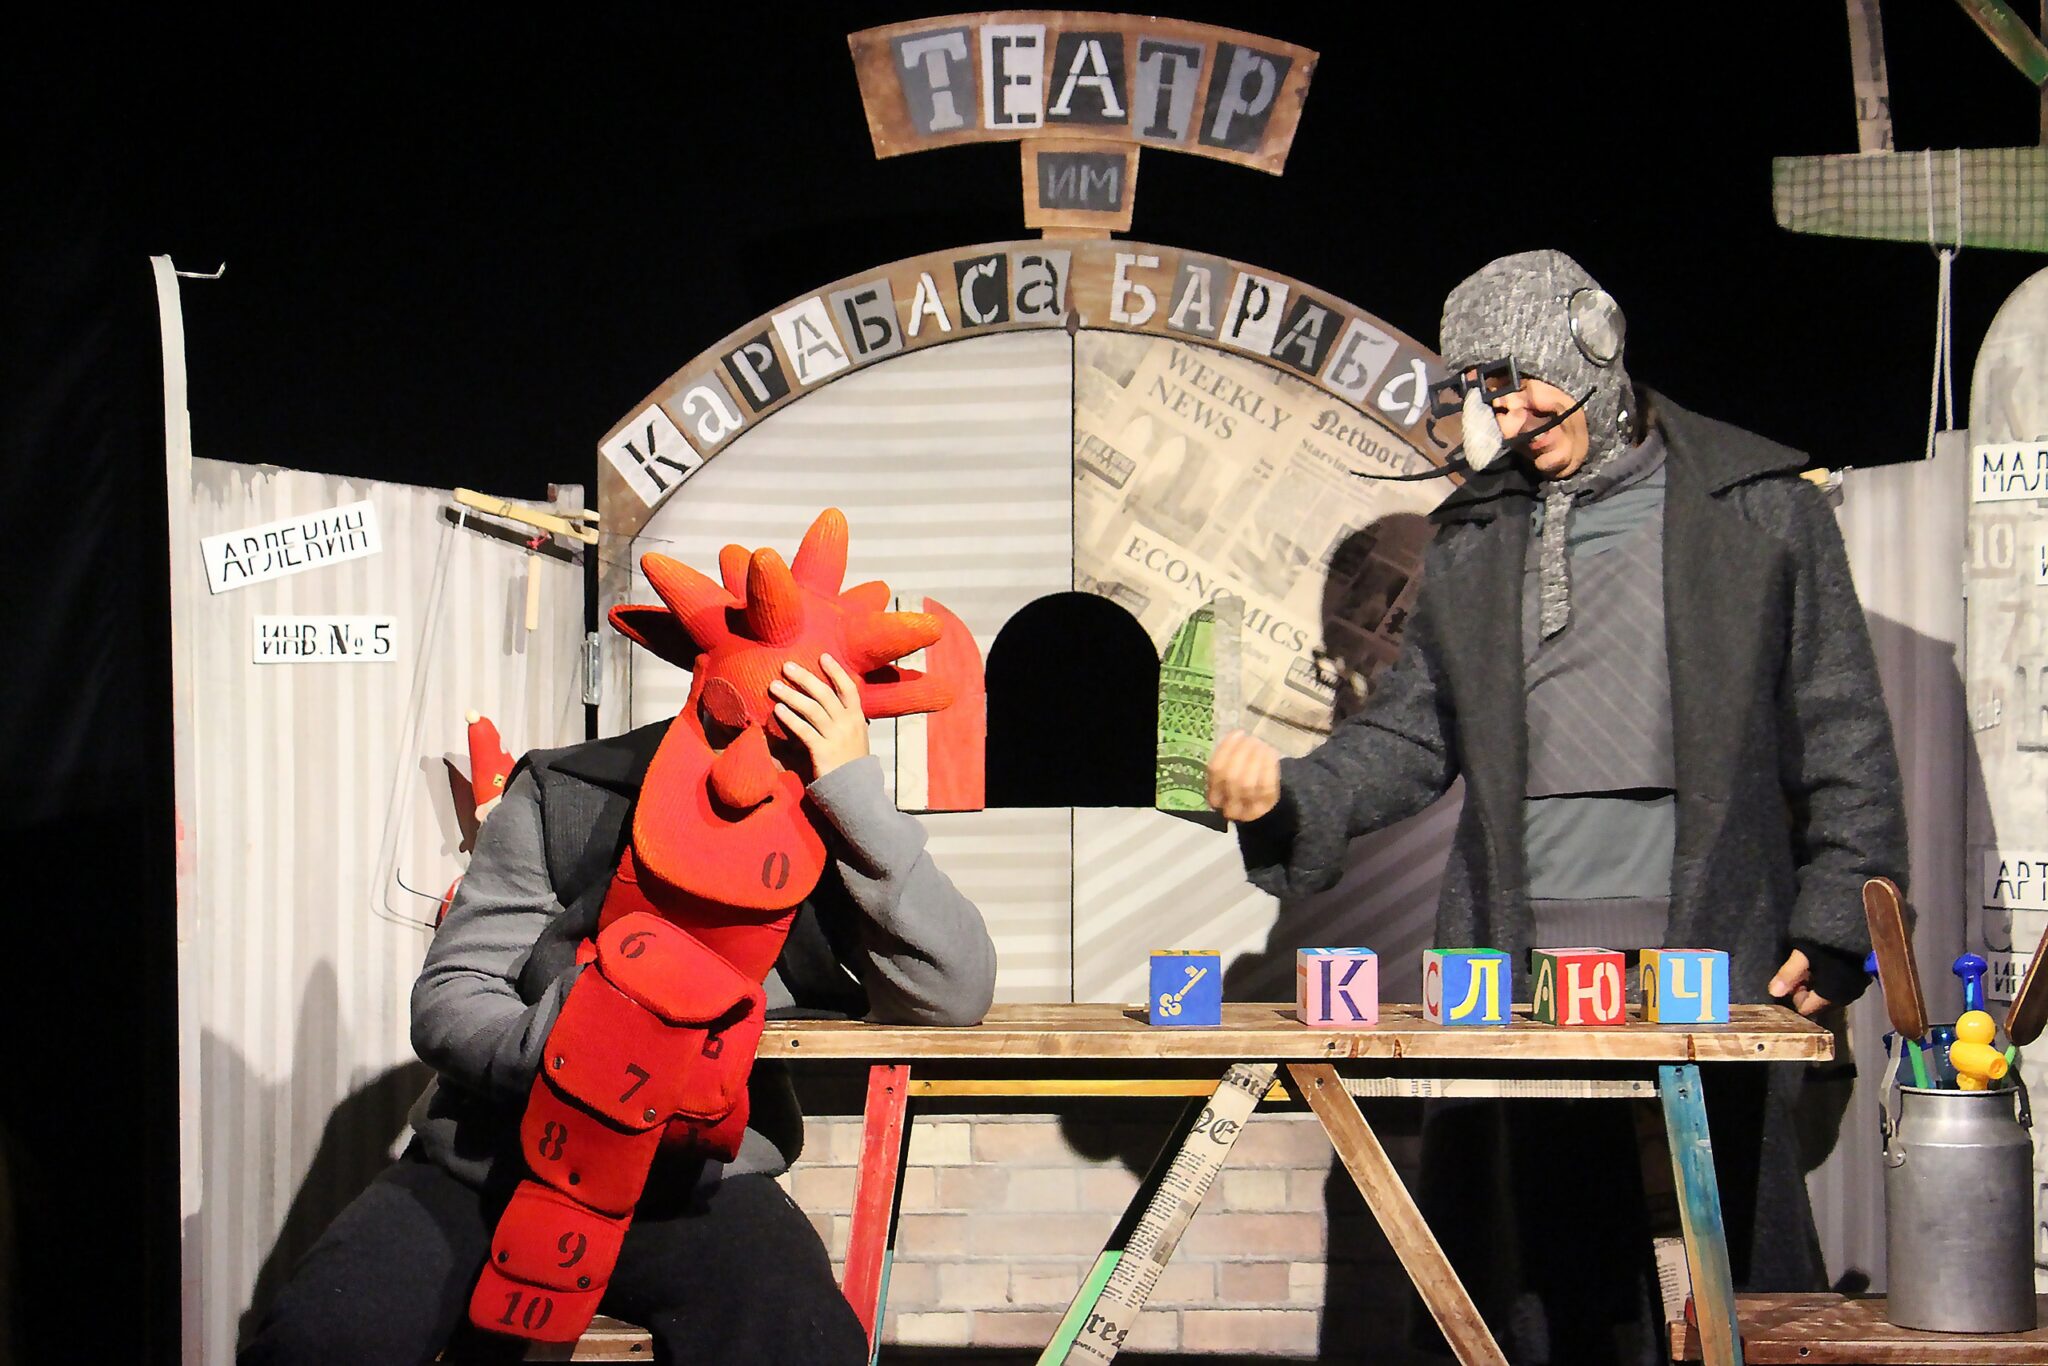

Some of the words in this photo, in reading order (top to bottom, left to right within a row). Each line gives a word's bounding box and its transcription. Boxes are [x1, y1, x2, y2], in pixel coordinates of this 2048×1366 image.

[899, 32, 1277, 142] ТЕАТР
[1147, 374, 1238, 440] NEWS
[1168, 346, 1293, 432] WEEKLY
[222, 510, 368, 583] АРЛЕКИН
[619, 1063, 653, 1104] 7
[538, 1120, 569, 1162] 8
[557, 1230, 587, 1269] 9
[496, 1290, 554, 1331] 10
